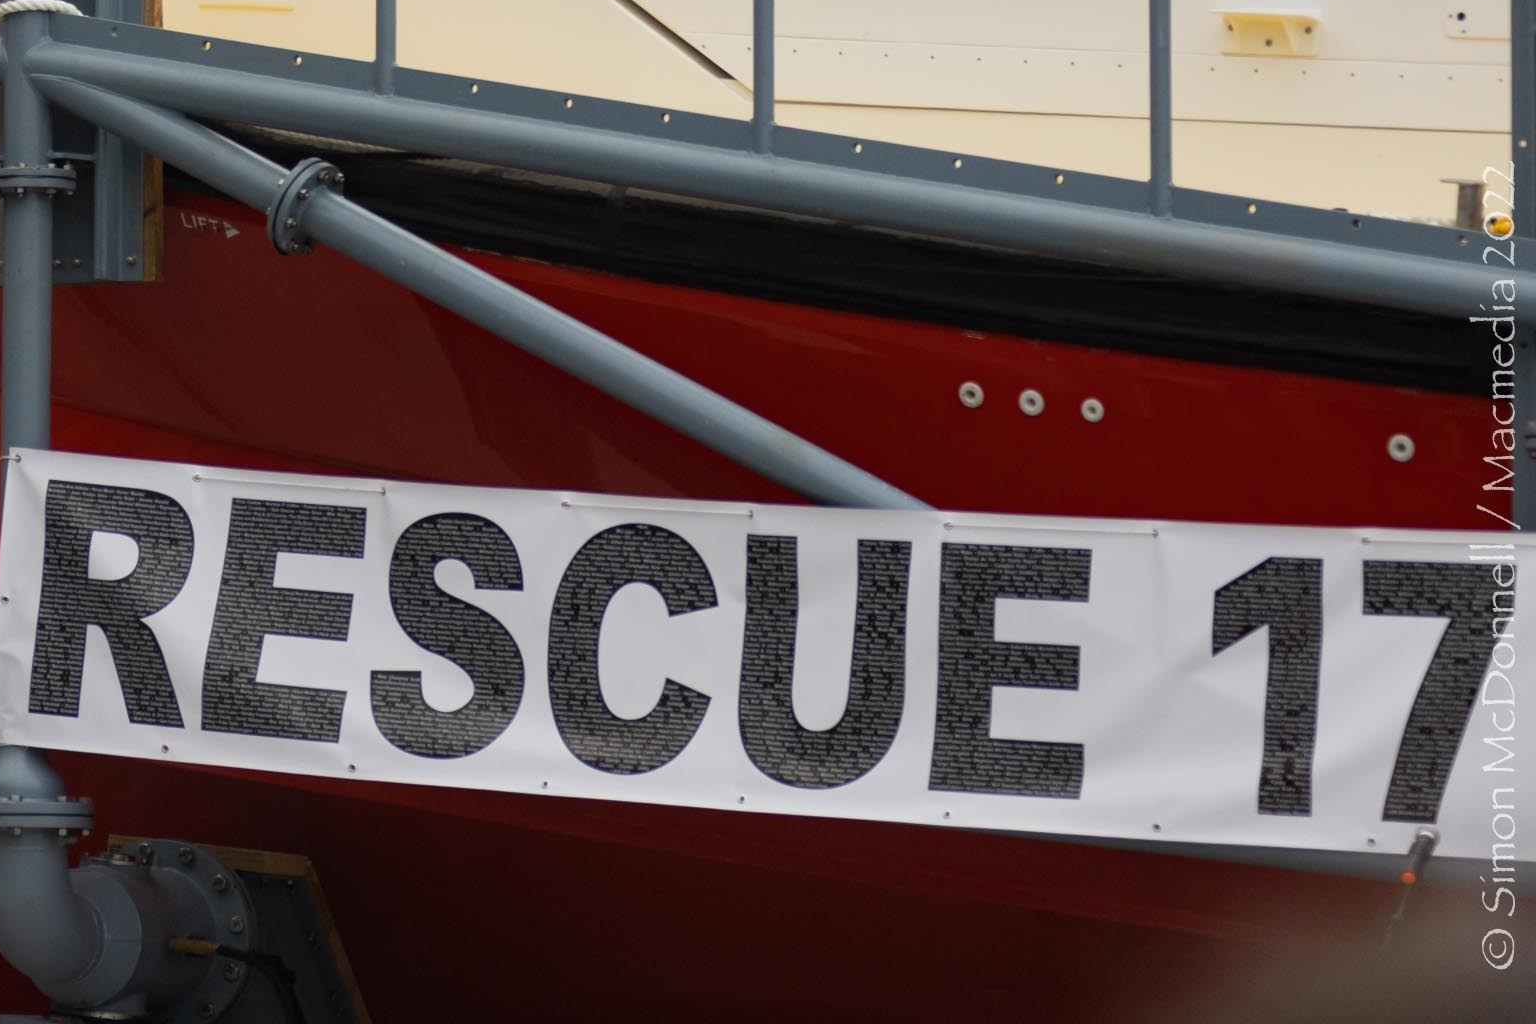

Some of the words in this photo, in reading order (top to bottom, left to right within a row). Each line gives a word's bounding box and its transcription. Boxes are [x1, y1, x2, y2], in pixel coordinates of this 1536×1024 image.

[180, 211, 219, 233] LIFT
[28, 479, 1092, 800] RESCUE
[1211, 556, 1517, 825] 17
